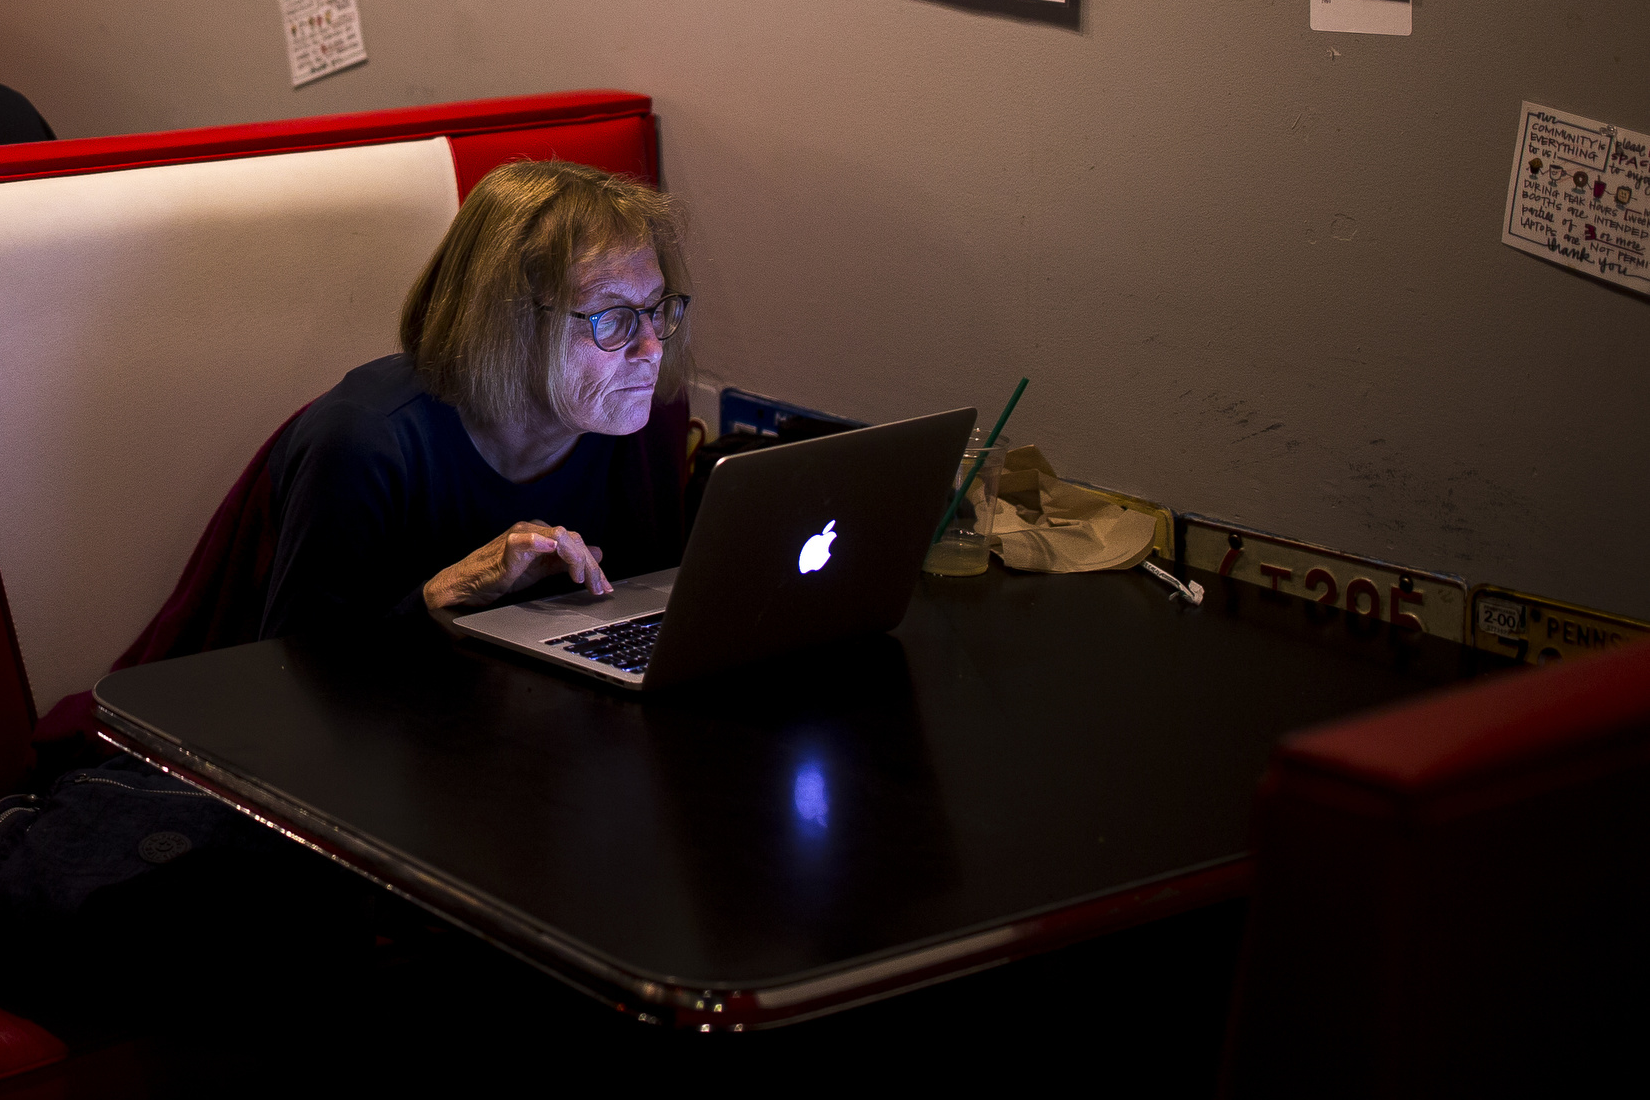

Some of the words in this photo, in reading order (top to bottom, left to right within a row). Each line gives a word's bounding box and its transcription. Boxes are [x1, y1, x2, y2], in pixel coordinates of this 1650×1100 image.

[1537, 111, 1558, 124] our
[1528, 143, 1540, 155] to
[1530, 131, 1599, 162] EVERYTHING
[1531, 122, 1598, 150] COMMUNITY
[1614, 138, 1646, 157] please
[1610, 152, 1650, 170] SPAC
[1524, 179, 1560, 198] DURING
[1563, 190, 1586, 206] PEAK
[1588, 200, 1619, 217] HOURS
[1521, 204, 1555, 223] parties
[1561, 217, 1578, 233] of
[1584, 223, 1597, 241] 3
[1600, 231, 1614, 242] or
[1615, 234, 1647, 252] more
[1522, 190, 1563, 212] BOOTHS
[1566, 205, 1589, 220] are
[1593, 215, 1650, 240] INTENDED
[1520, 216, 1558, 238] LAPTOPS
[1562, 232, 1581, 246] are
[1590, 241, 1616, 258] NOT
[1617, 250, 1650, 270] PERMI
[1547, 236, 1596, 265] thank
[1598, 256, 1629, 277] you
[1484, 609, 1516, 629] 2-00
[1547, 616, 1623, 648] PENNS
